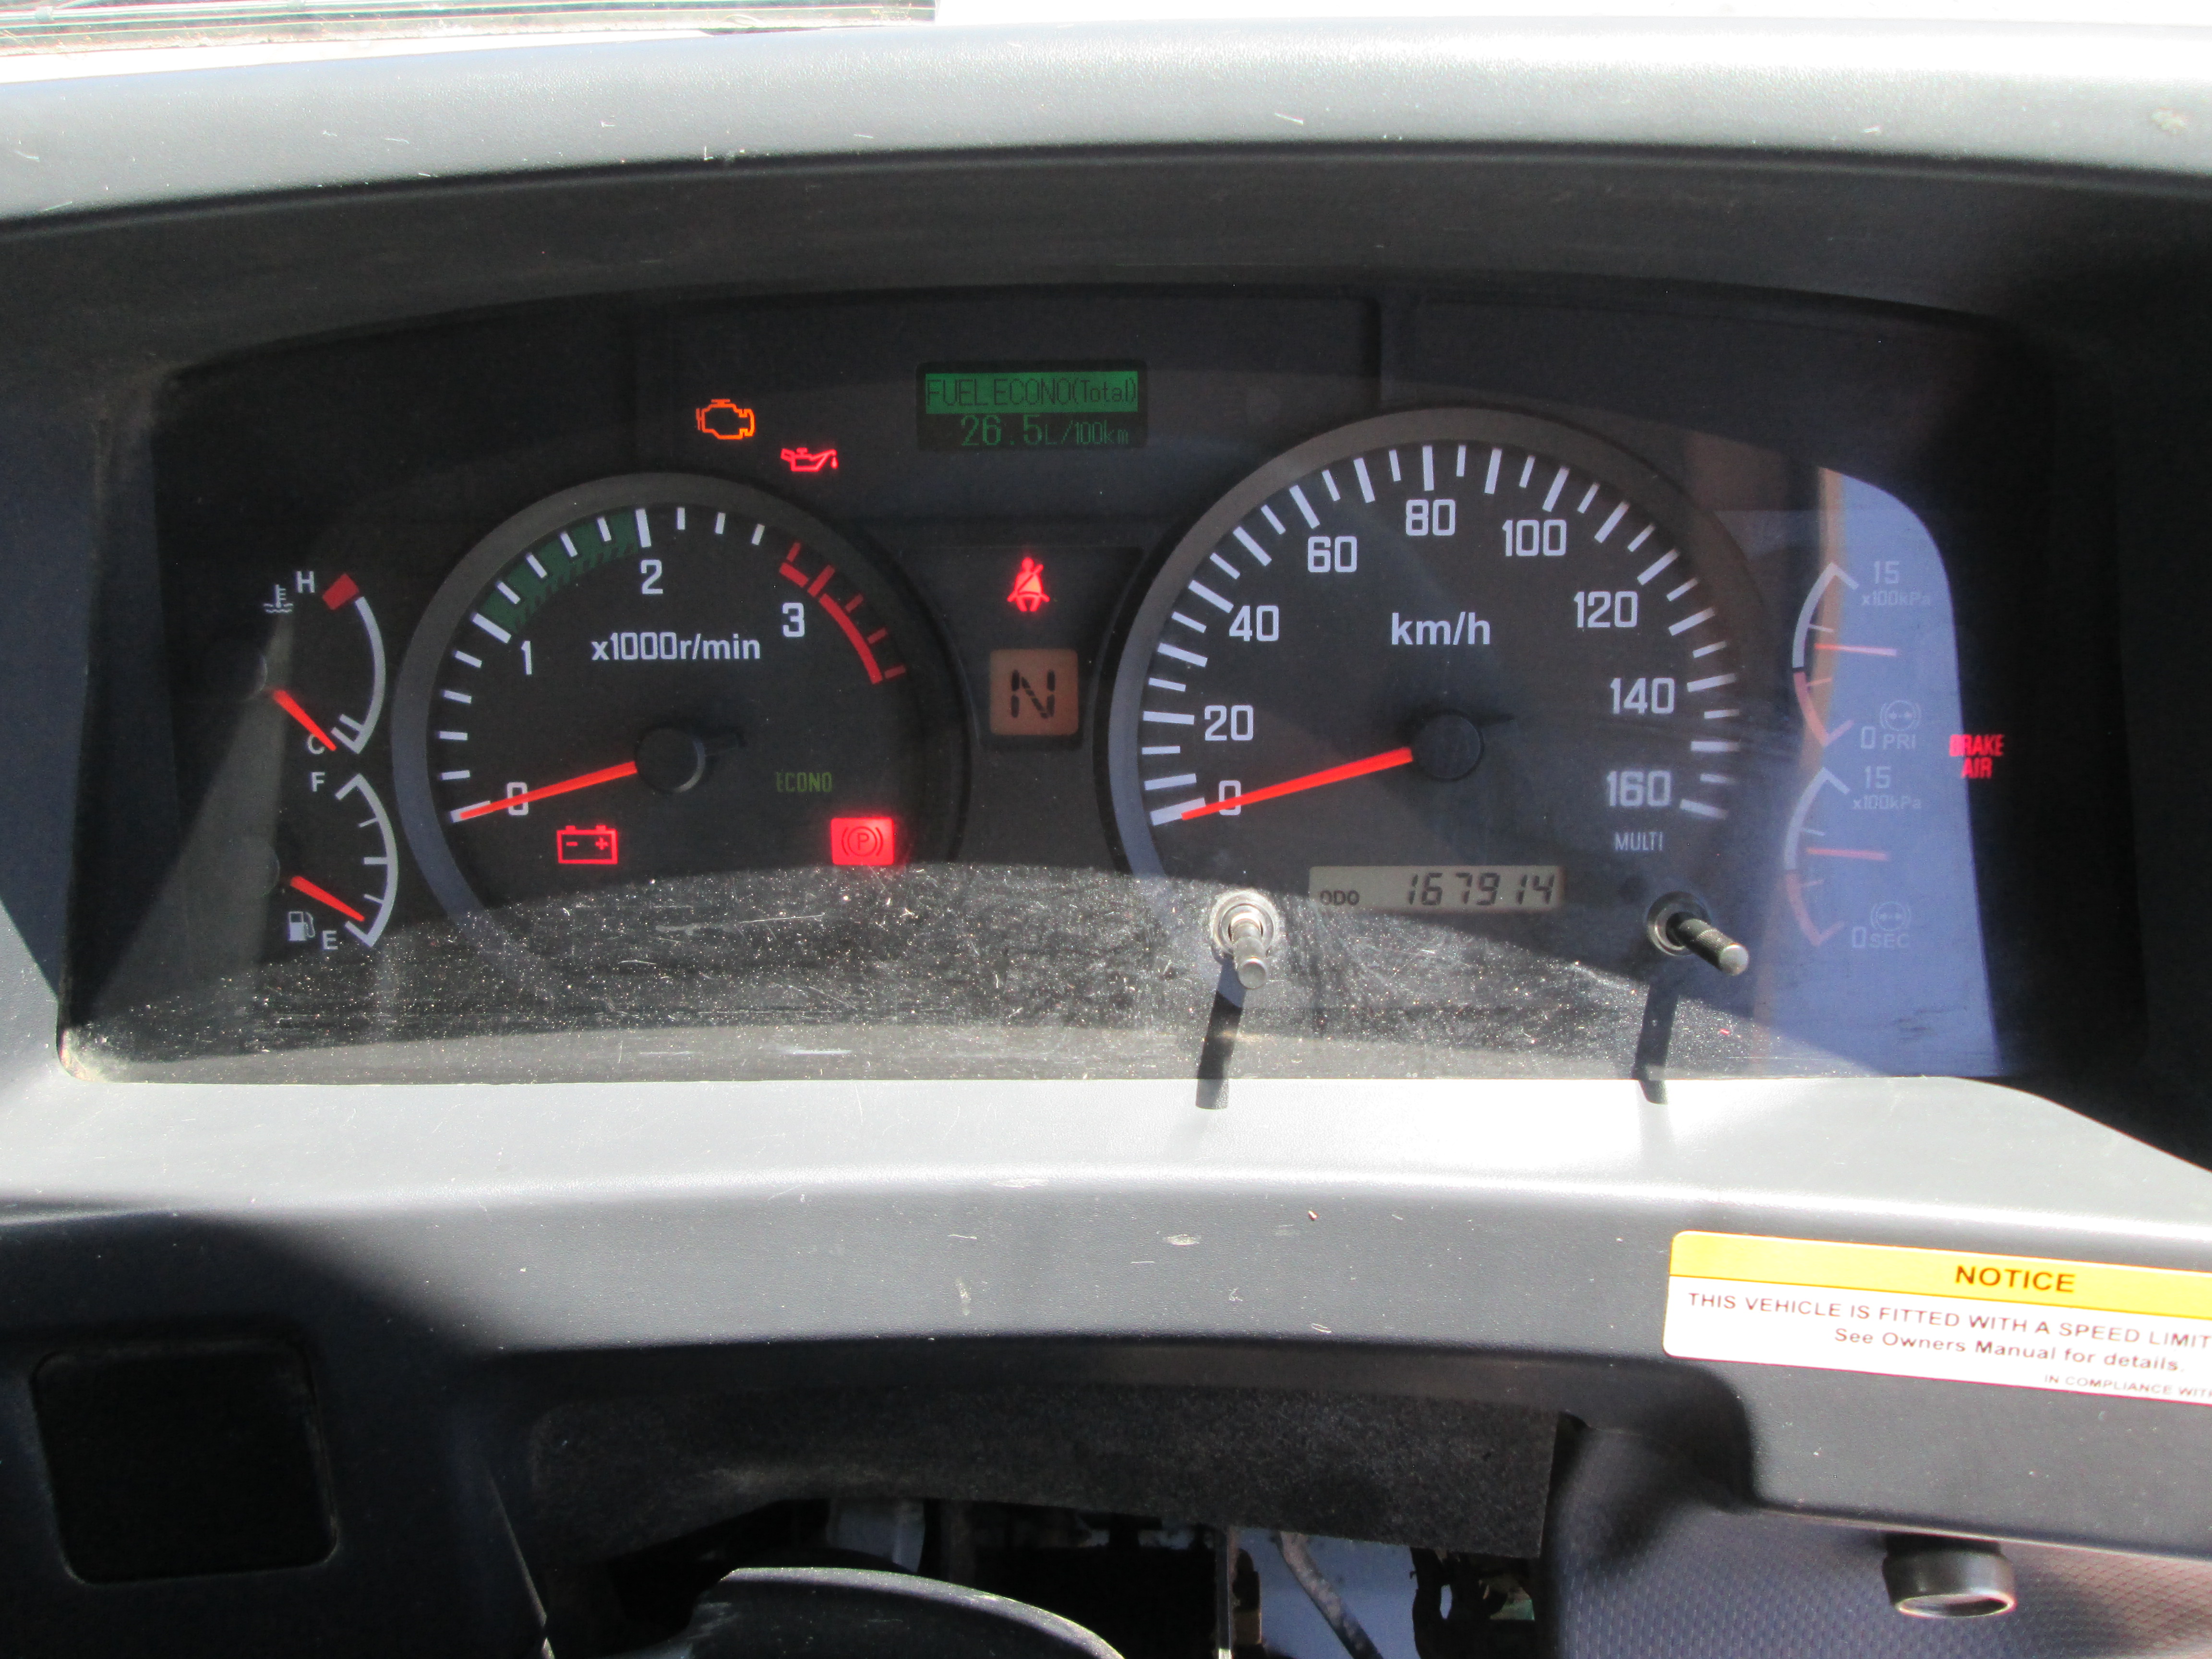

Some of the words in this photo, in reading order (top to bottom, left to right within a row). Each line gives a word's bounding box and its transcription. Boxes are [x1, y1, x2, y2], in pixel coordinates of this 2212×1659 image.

[926, 378, 988, 406] FUEL
[1405, 498, 1456, 536] 80
[1502, 518, 1567, 557] 100
[1307, 536, 1358, 573] 60
[296, 570, 315, 594] H
[640, 559, 663, 595] 2
[1874, 560, 1900, 585] 15
[1573, 590, 1638, 629] 120
[1861, 590, 1931, 607] x100kPa
[781, 602, 805, 637] 3
[1228, 604, 1279, 642] 40
[1391, 612, 1491, 645] km/h
[521, 640, 533, 675] 1
[590, 631, 760, 661] x1000r/min
[1011, 669, 1055, 719] N
[1609, 676, 1675, 715] 140
[1204, 705, 1254, 742] 20
[307, 733, 326, 756] C
[1882, 733, 1917, 750] PRI
[1949, 733, 2005, 758] BRAKE
[311, 771, 326, 792] F
[776, 771, 833, 793] ECONO
[1864, 766, 1891, 790] 15
[1961, 758, 1993, 780] AIR
[506, 781, 529, 817] 0
[1218, 779, 1242, 816] 0
[1606, 769, 1671, 807] 160
[1852, 793, 1922, 811] x100kPa
[856, 832, 870, 850] P
[1614, 831, 1664, 852] MULTI
[1319, 889, 1360, 906] ODO
[1407, 871, 1555, 906] 167914
[322, 930, 338, 951] E
[1852, 926, 1867, 950] 0
[1869, 933, 1911, 950] SEC
[1955, 1264, 2077, 1294] NOTICE
[1688, 1292, 1737, 1310] THIS
[1745, 1297, 1842, 1318] VEHICLE
[1851, 1305, 1871, 1319] IS
[1878, 1307, 1960, 1327] FITTED
[1968, 1314, 2028, 1333] WITH
[2034, 1321, 2051, 1334] A
[2059, 1322, 2140, 1343] SPEED
[1834, 1328, 1874, 1344] See
[1882, 1332, 1967, 1352] Owners
[1975, 1340, 2057, 1360] Manual
[2065, 1347, 2096, 1364] for
[2104, 1355, 2185, 1373] details.
[2044, 1374, 2060, 1384] IN
[2065, 1376, 2173, 1395] COMPLIANCE
